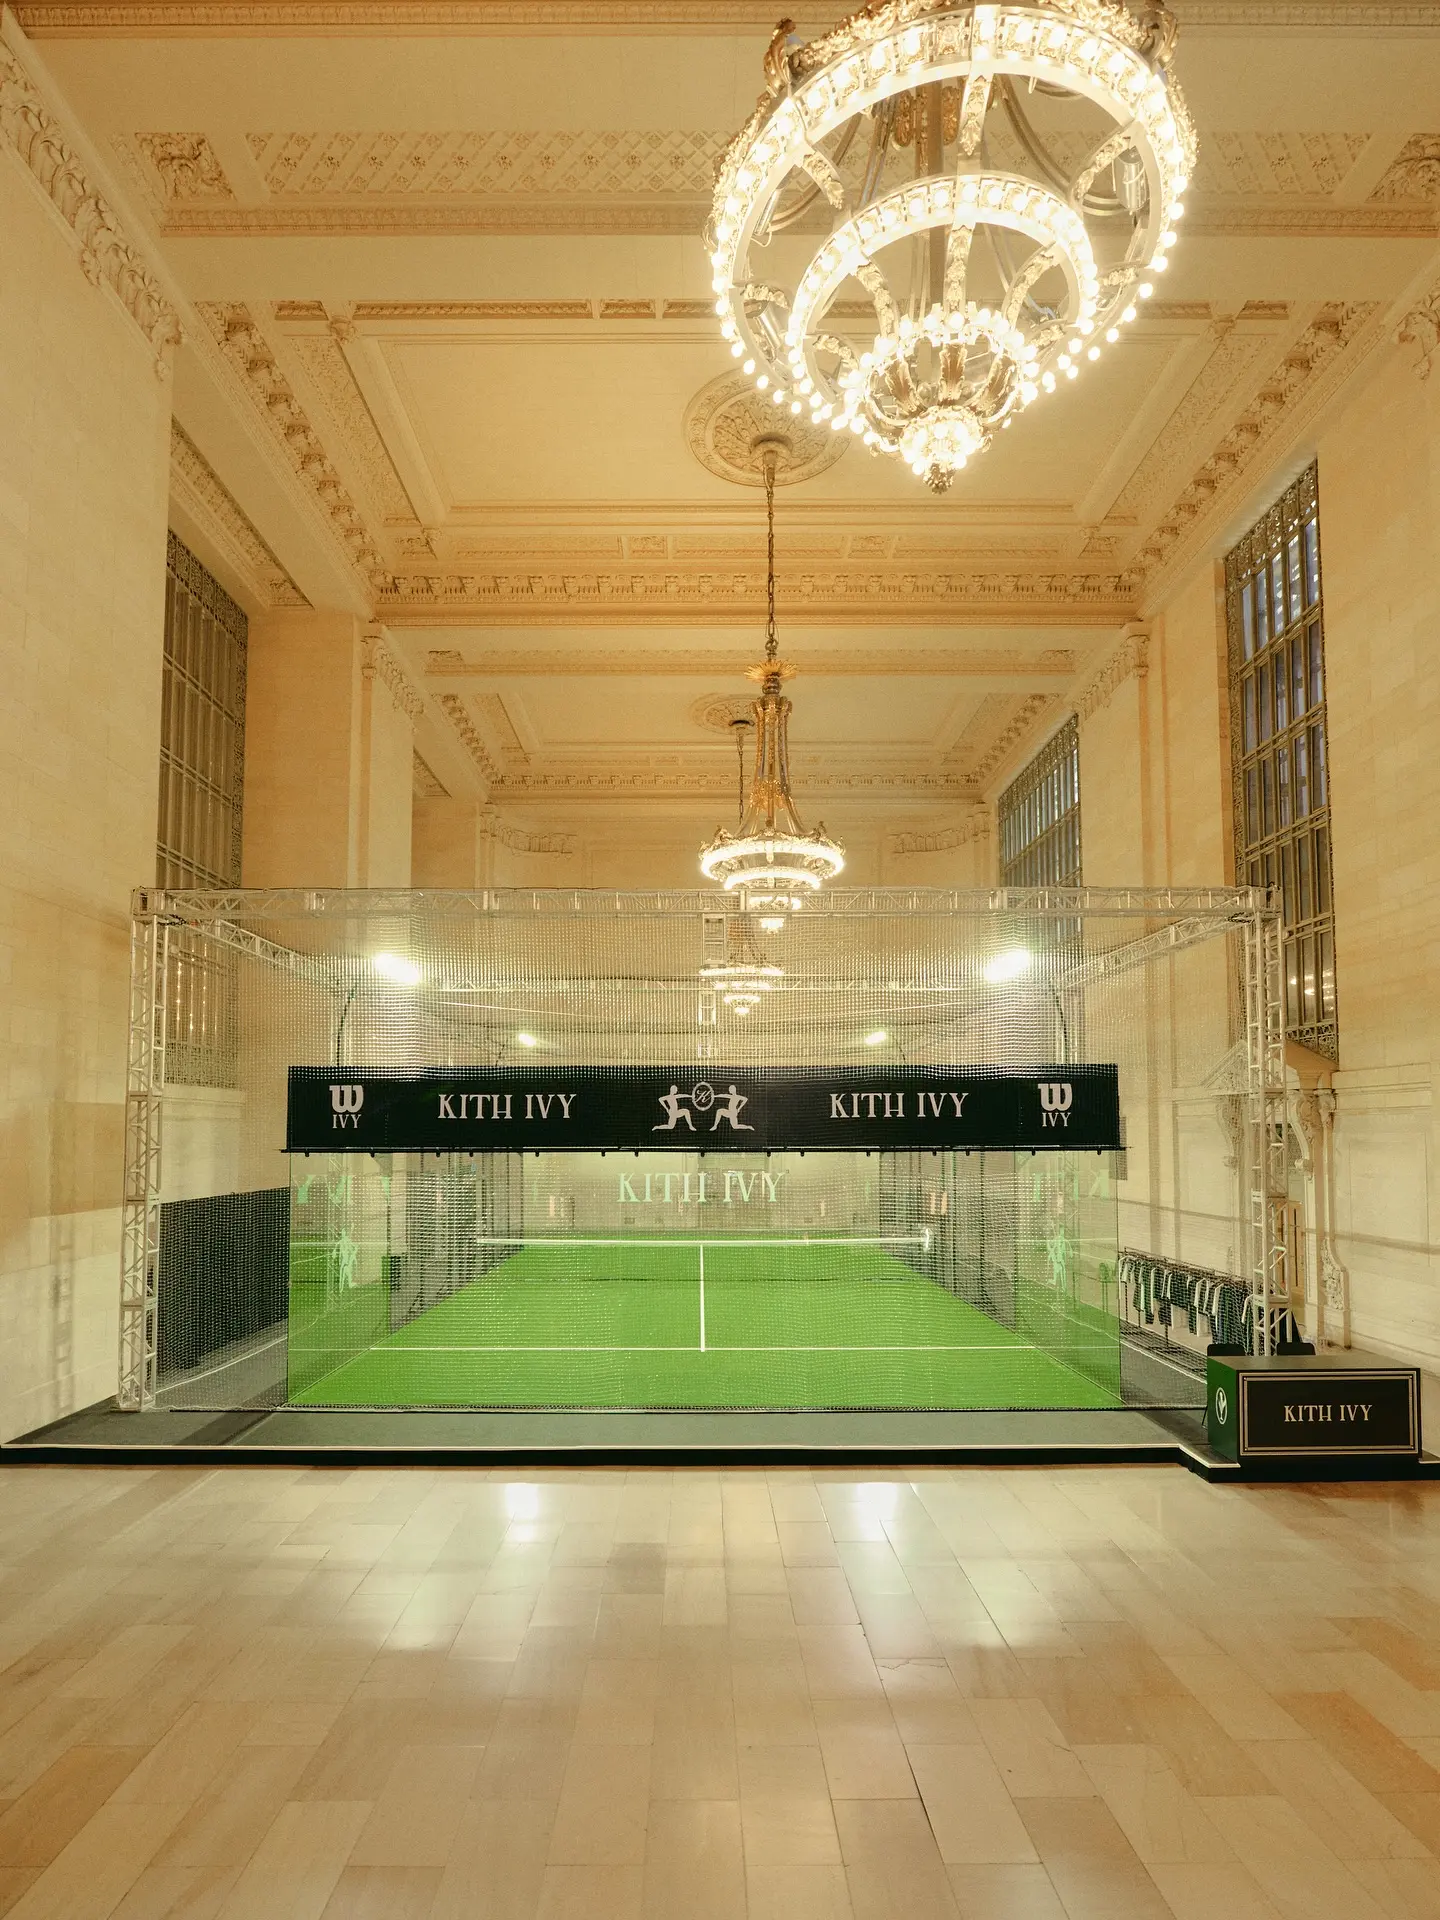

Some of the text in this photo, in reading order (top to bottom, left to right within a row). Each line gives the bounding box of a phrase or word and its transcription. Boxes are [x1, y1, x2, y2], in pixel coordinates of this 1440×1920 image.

[438, 1094, 576, 1118] KITH IVY
[830, 1093, 968, 1118] KITH IVY
[333, 1115, 361, 1128] IVY
[1042, 1113, 1070, 1126] IVY
[616, 1171, 785, 1203] KITH IVY
[1285, 1405, 1373, 1422] KITH IVY
